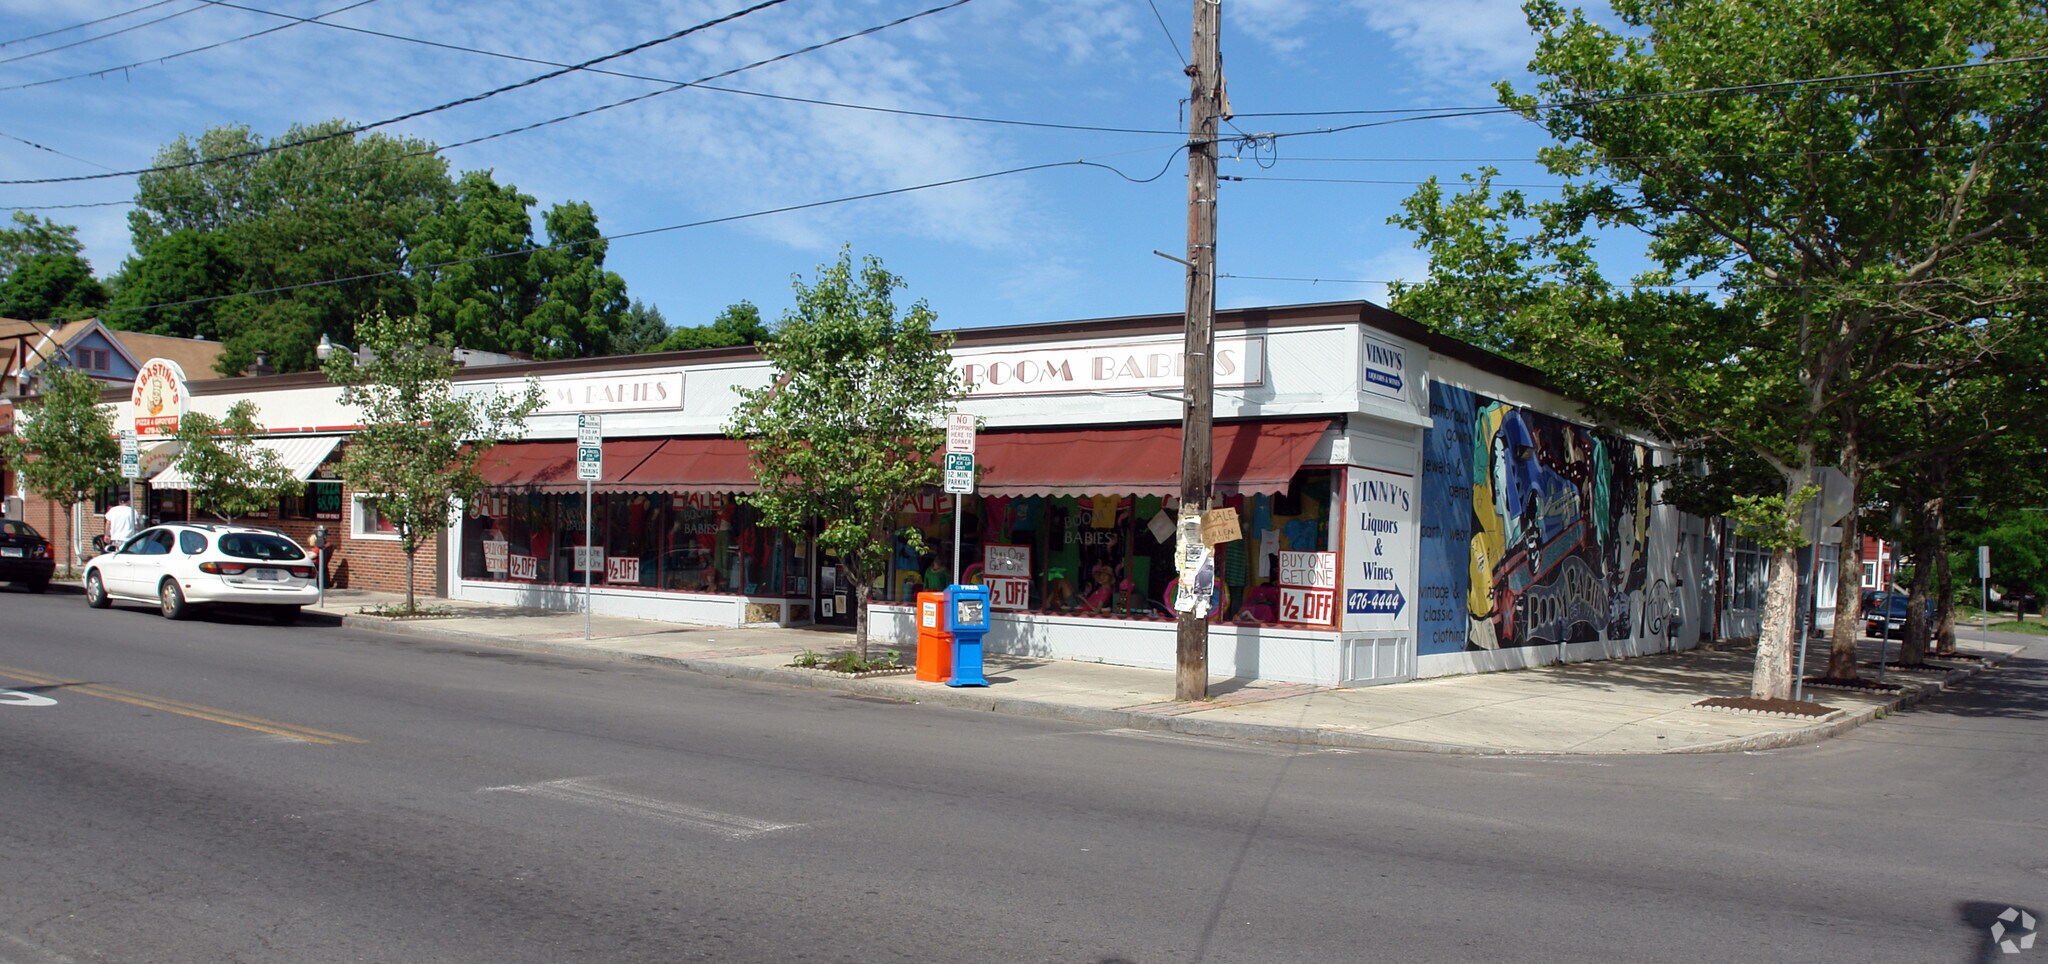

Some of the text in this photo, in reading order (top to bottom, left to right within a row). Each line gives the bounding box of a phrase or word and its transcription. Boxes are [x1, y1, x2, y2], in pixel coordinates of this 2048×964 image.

[1366, 343, 1402, 371] VINNY'S
[963, 349, 1237, 386] BOOM BABIS
[1368, 371, 1385, 382] LIQUORS
[134, 364, 179, 407] SABASTINO'S
[585, 379, 667, 404] BABIES
[155, 416, 178, 425] GROCERY
[580, 416, 585, 426] 2
[956, 416, 967, 424] NO
[1432, 404, 1469, 425] amorous
[1455, 459, 1463, 477] &
[317, 496, 340, 512] $8.99
[673, 491, 721, 510] SALE
[888, 494, 952, 513] ALE
[1352, 480, 1410, 512] VINNY'S
[1449, 486, 1470, 507] gems
[470, 494, 509, 519] SALE
[1211, 510, 1236, 521] SALE
[684, 523, 718, 535] BABIES
[1361, 512, 1398, 536] Liquors
[1064, 531, 1113, 545] BABIES
[1421, 525, 1469, 545] party wear
[990, 547, 1026, 560] Buy One
[1374, 538, 1383, 556] &
[521, 557, 537, 577] OFF
[619, 559, 638, 580] OFF
[1007, 560, 1024, 572] One
[1281, 553, 1334, 570] BUY ONE
[1280, 569, 1334, 587] GET ONE
[1362, 562, 1394, 581] Wines
[1005, 580, 1028, 606] OFF
[1348, 592, 1400, 610] 476-4444
[1420, 582, 1460, 605] vintage &
[1303, 593, 1332, 621] OFF
[1424, 605, 1453, 621] classic
[1528, 588, 1569, 632] BOOM
[1433, 628, 1466, 650] clothing
